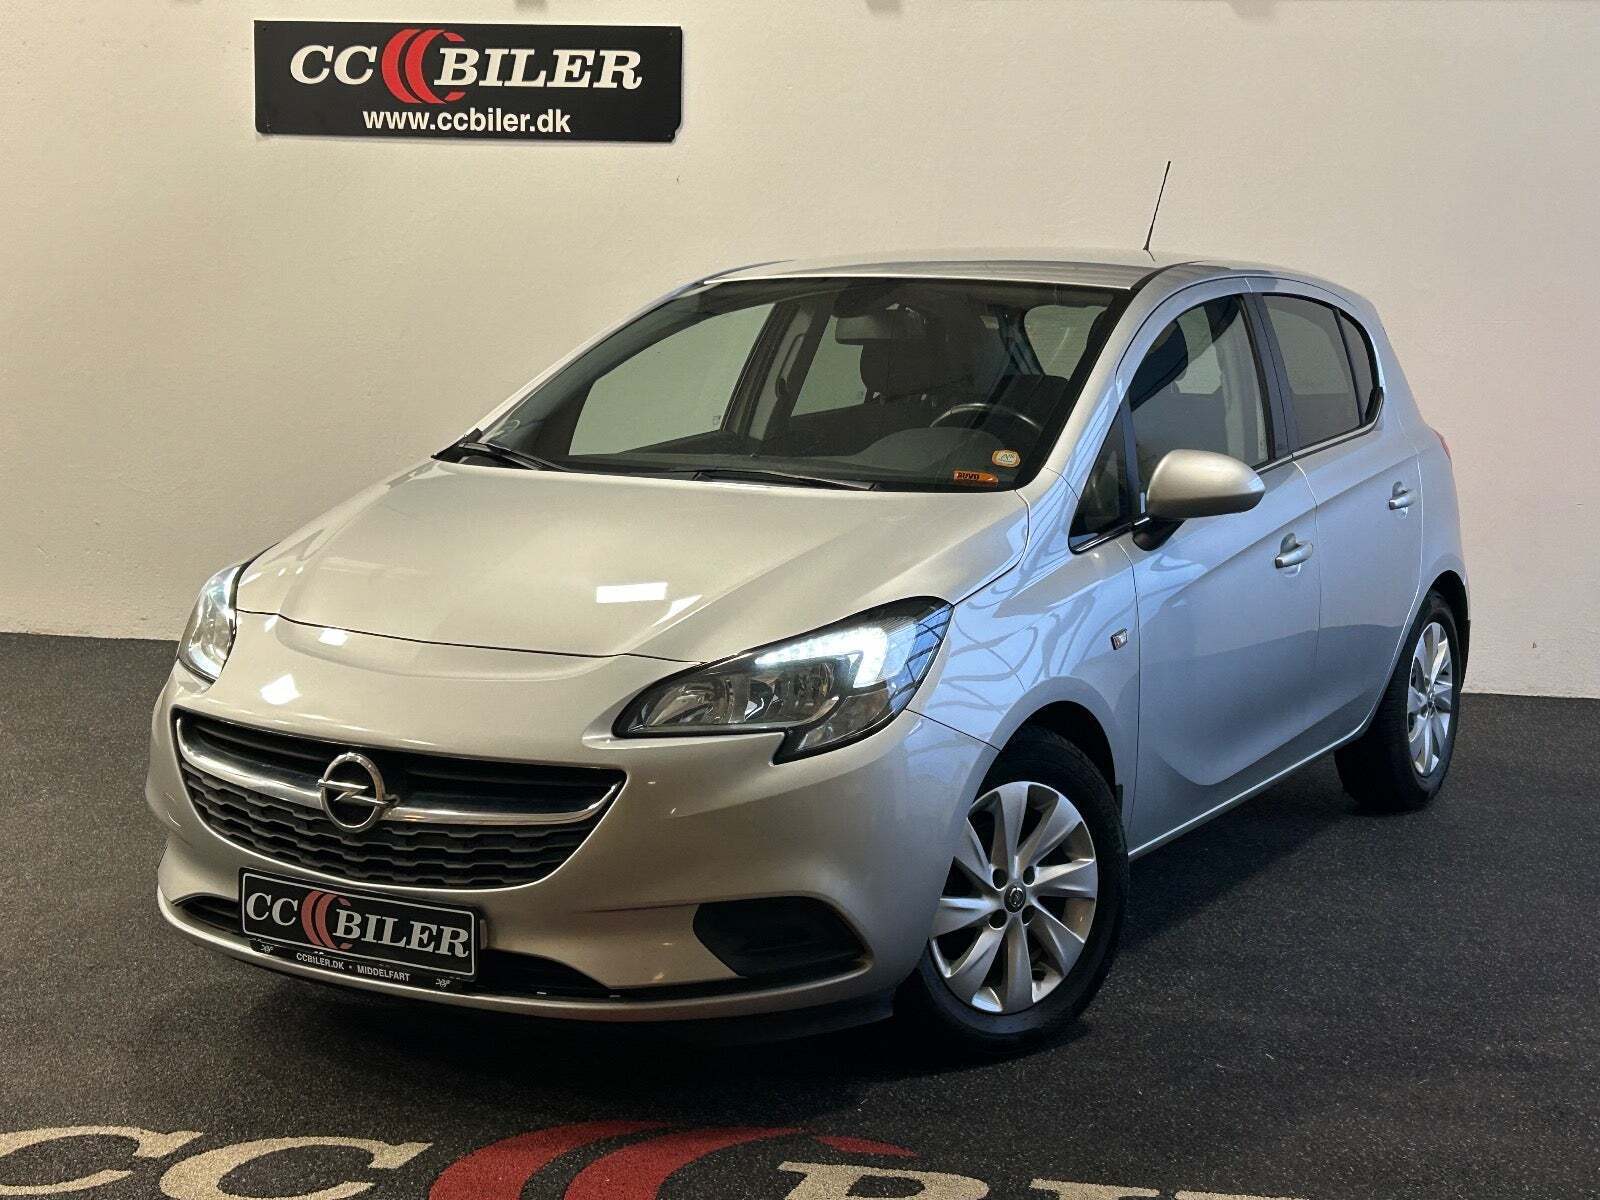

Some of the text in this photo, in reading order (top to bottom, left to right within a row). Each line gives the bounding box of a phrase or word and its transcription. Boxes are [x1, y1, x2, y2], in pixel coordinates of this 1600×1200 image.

[290, 45, 642, 89] CC BILER
[363, 107, 571, 134] www.ccbiler.dk
[246, 892, 469, 958] CC BILER
[296, 952, 410, 982] CCBILER.DK MIDDELFART
